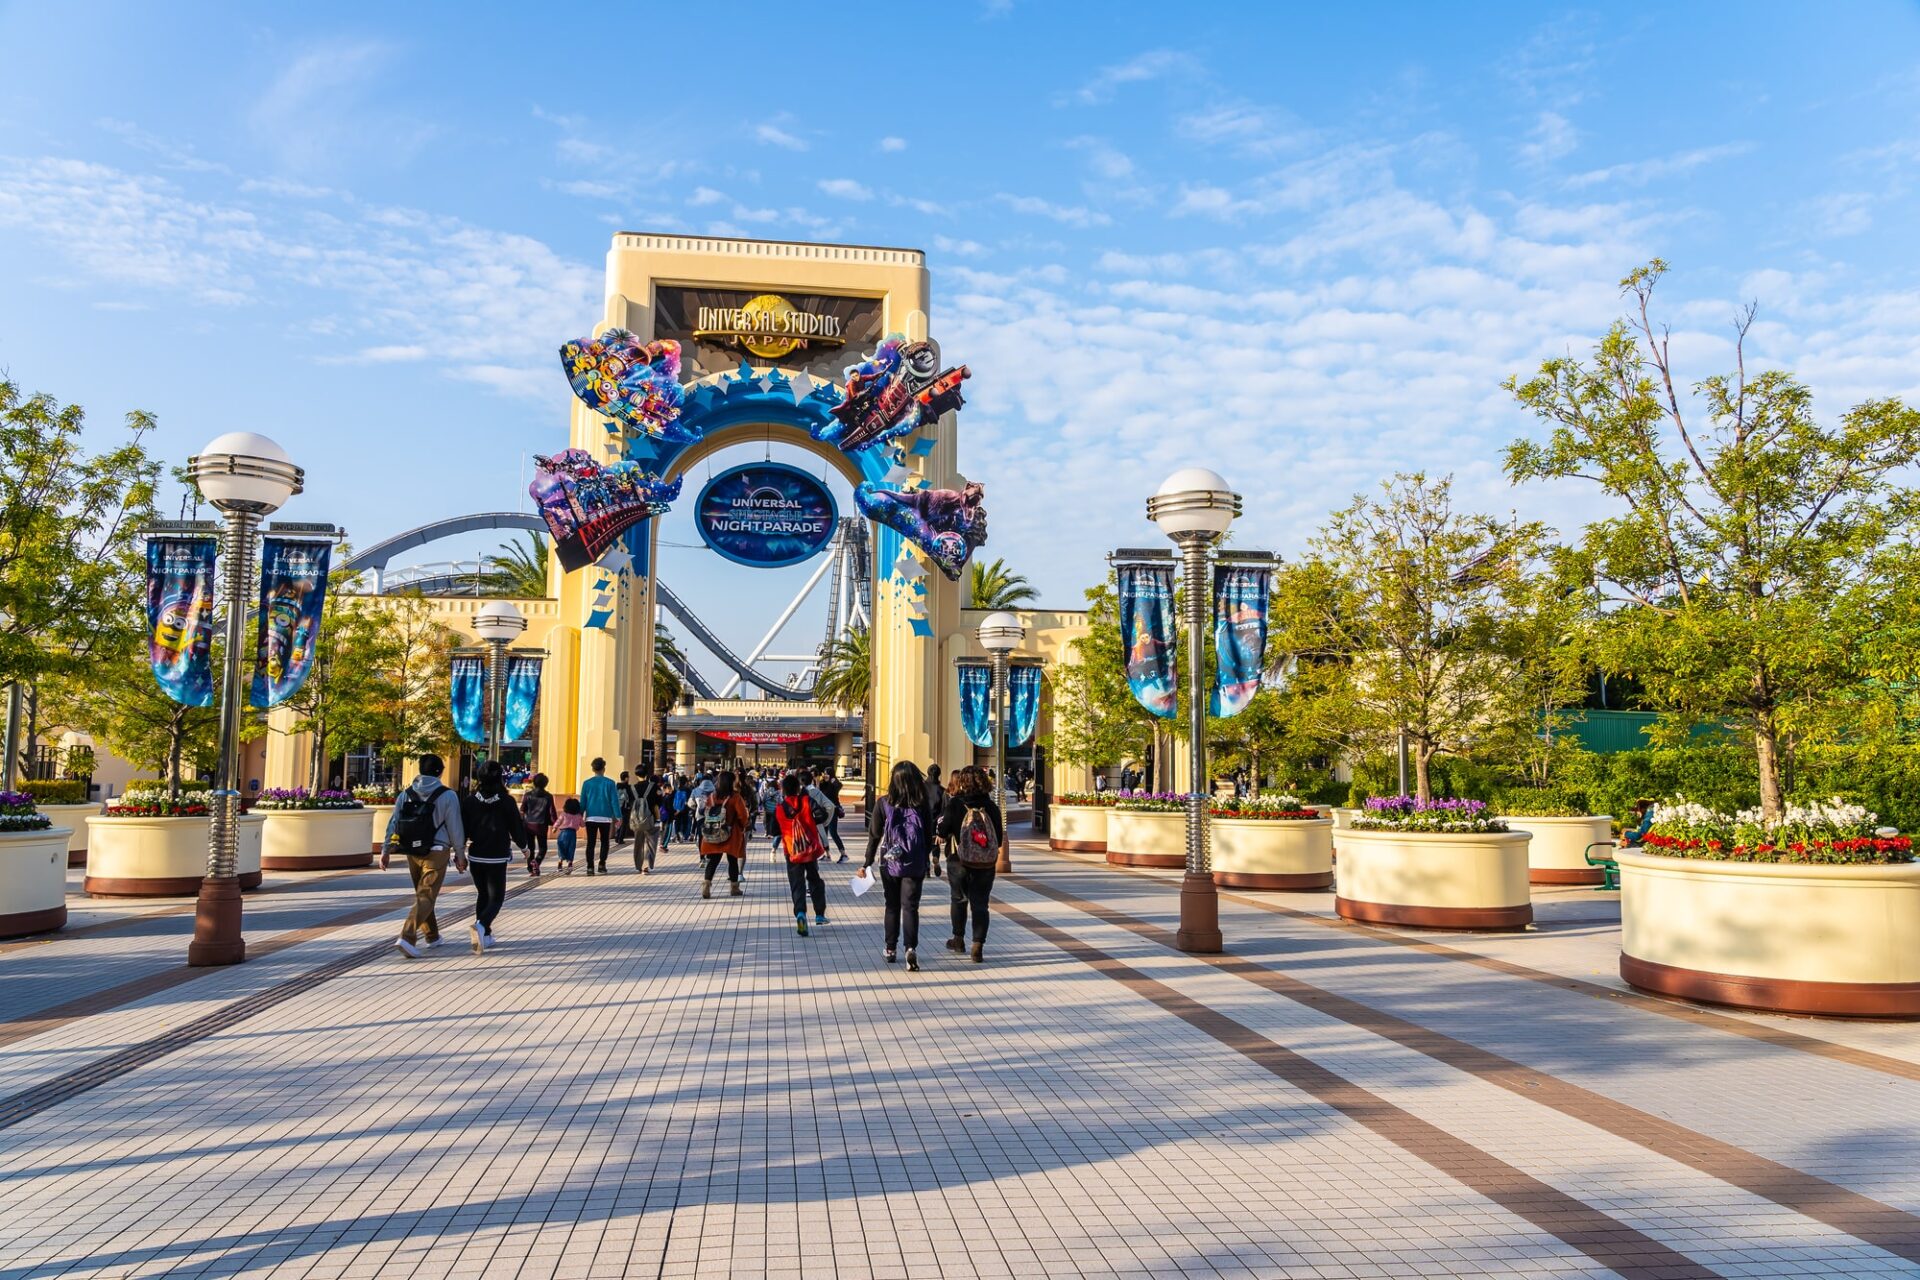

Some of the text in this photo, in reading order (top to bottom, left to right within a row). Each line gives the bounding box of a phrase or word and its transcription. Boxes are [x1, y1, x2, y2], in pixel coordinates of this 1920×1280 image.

[698, 306, 841, 337] UNIVERSAL STUDIOS
[730, 335, 809, 349] JAPAN
[732, 498, 802, 509] UNIVERSAL
[728, 509, 802, 520] SPECTACLE
[711, 520, 823, 533] NIGHT PARADE
[265, 568, 327, 577] NIGHT PARADE
[1145, 591, 1172, 599] PARADE
[744, 711, 780, 722] TICKETS
